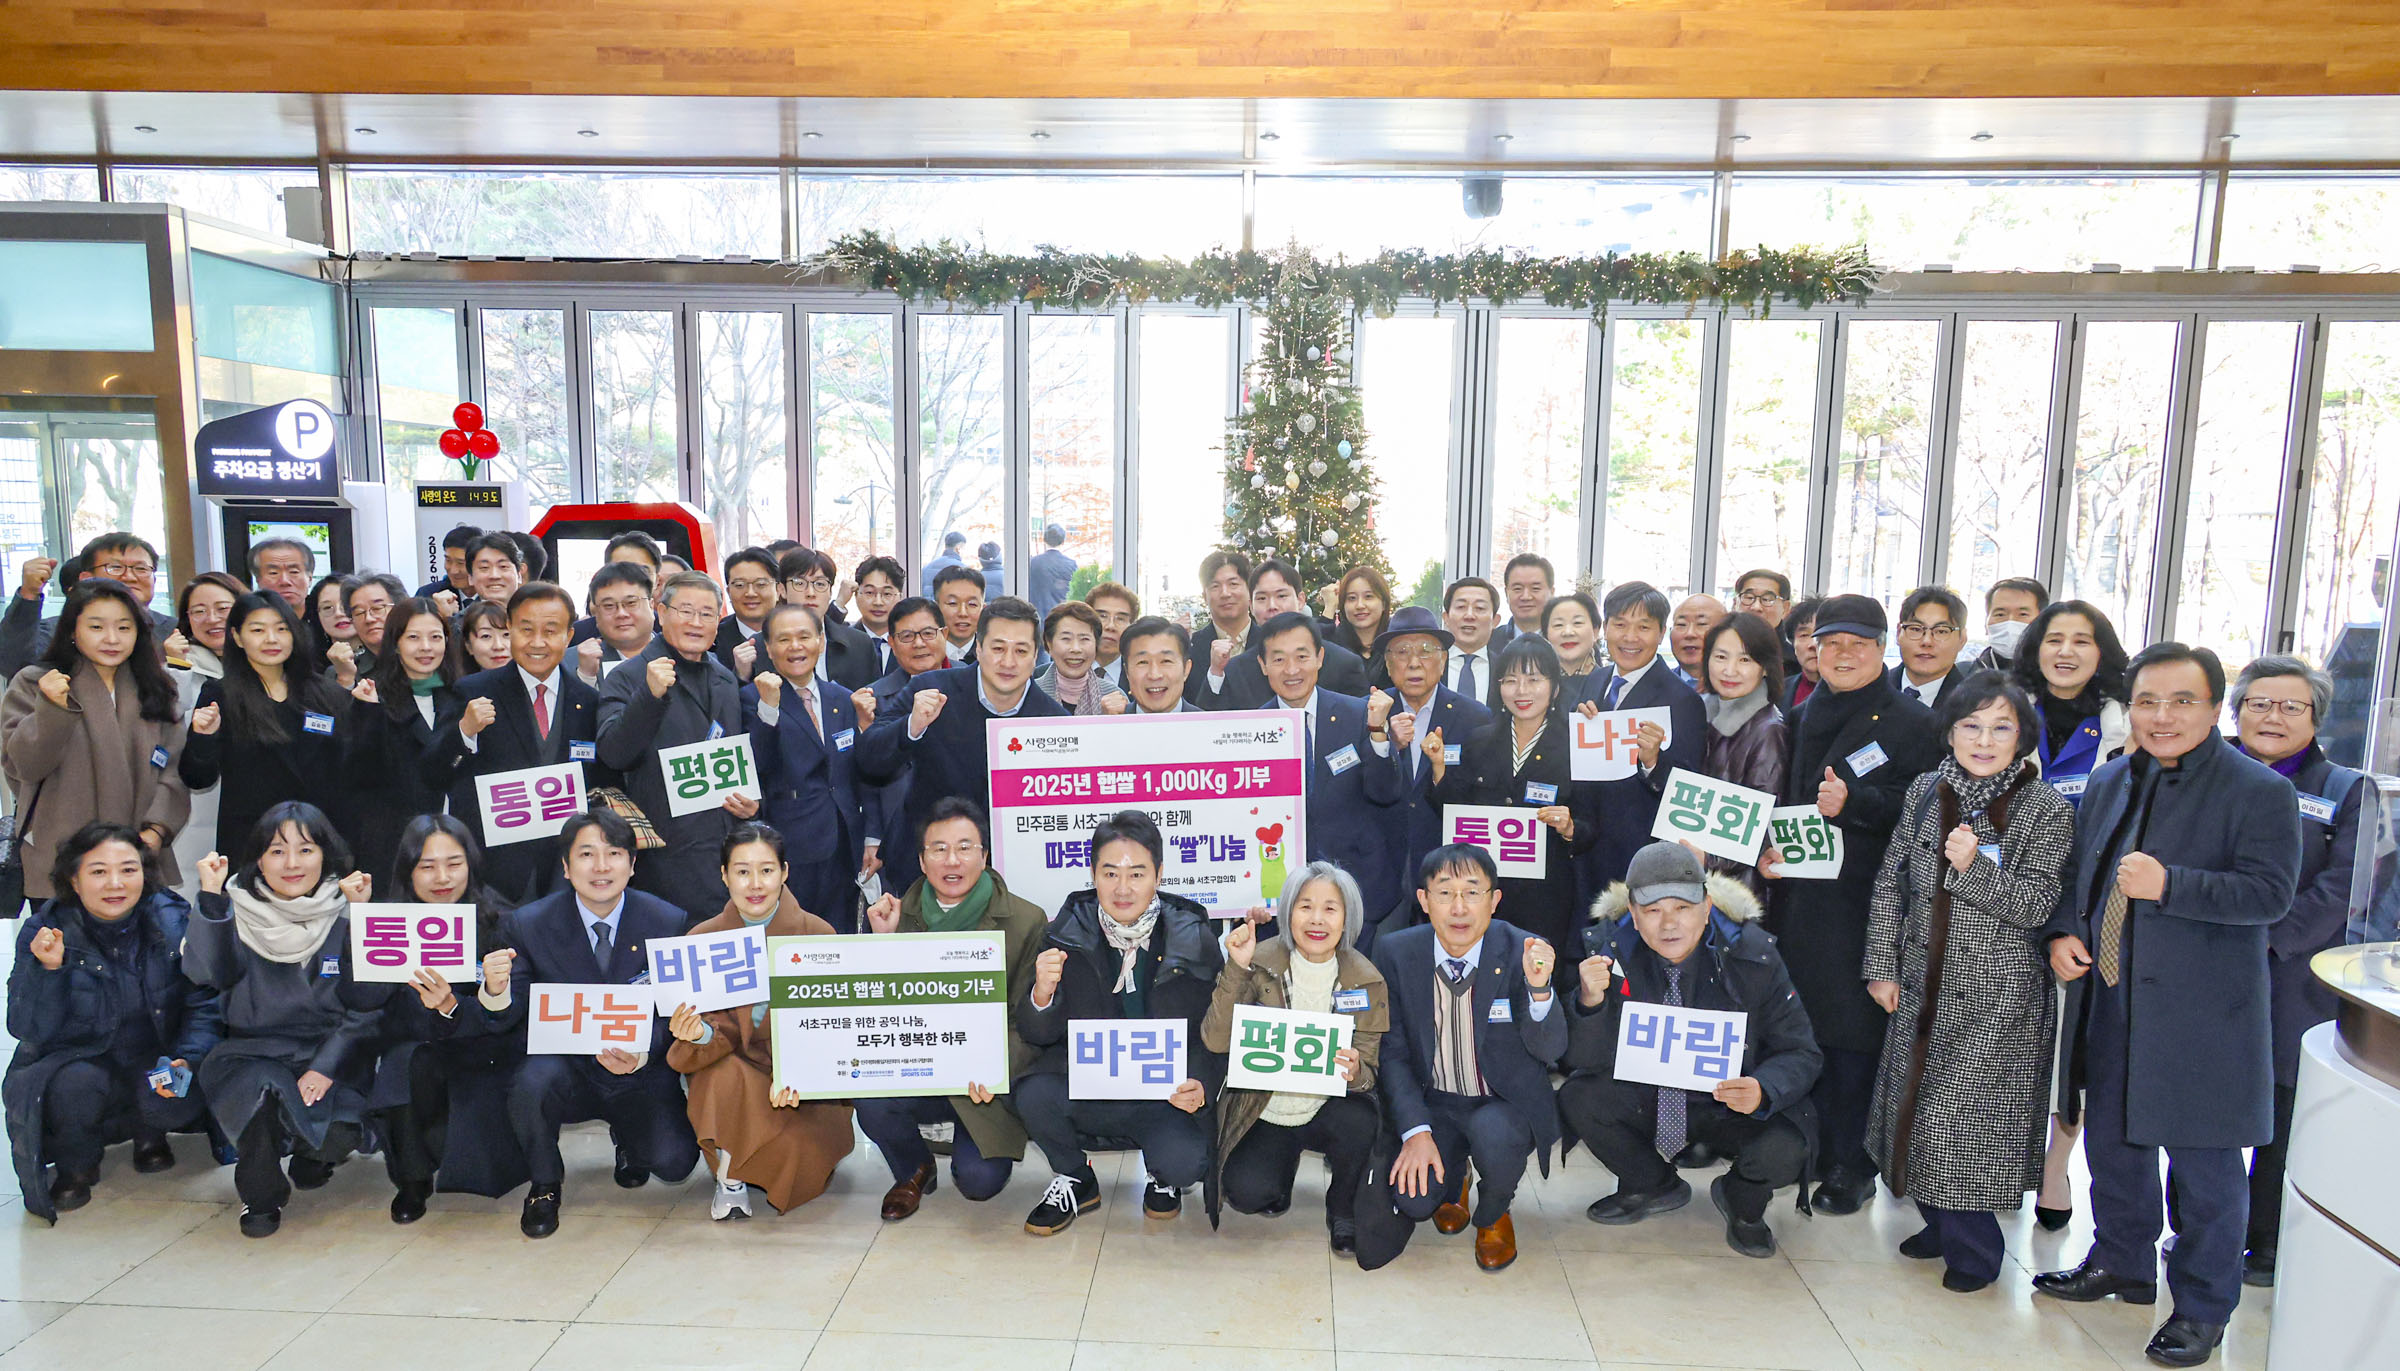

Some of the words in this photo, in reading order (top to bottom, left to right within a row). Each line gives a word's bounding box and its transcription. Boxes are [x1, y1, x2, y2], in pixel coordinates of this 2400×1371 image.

[295, 412, 319, 449] P
[213, 460, 273, 480] 주차요금
[276, 461, 321, 481] 정산기
[420, 490, 441, 503] 사랑의
[443, 490, 457, 503] 온도
[1025, 736, 1079, 749] 사랑의열매
[1253, 730, 1279, 744] 서초
[669, 746, 748, 799] 평화
[1021, 773, 1092, 798] 2025년
[1097, 770, 1137, 796] 햅쌀
[1142, 768, 1228, 796] 1,000Kg
[1233, 766, 1271, 790] 기부
[490, 773, 578, 829] 통일
[1668, 780, 1761, 846] 평화
[1016, 814, 1069, 833] 민주평통
[1166, 809, 1192, 827] 함께
[1772, 815, 1835, 864] 평화
[1182, 876, 1195, 885] 서울
[1197, 874, 1237, 885] 서초구협의회
[363, 917, 464, 967] 통일
[970, 949, 989, 960] 서초
[655, 936, 762, 994] 바람
[787, 981, 849, 999] 2025년
[853, 980, 885, 999] 햅쌀
[888, 980, 959, 1000] 1,000kg
[963, 978, 995, 996] 기부
[539, 994, 647, 1042] 나눔
[799, 1017, 852, 1030] 서초구민을
[855, 1016, 876, 1028] 위한
[879, 1016, 900, 1027] 공익
[902, 1016, 927, 1028] 나눔,
[857, 1033, 896, 1047] 모두가
[899, 1032, 938, 1047] 행복한
[941, 1031, 967, 1046] 하루
[1240, 1019, 1341, 1076] 평화
[1628, 1013, 1740, 1080] 바람
[1076, 1029, 1182, 1084] 바람
